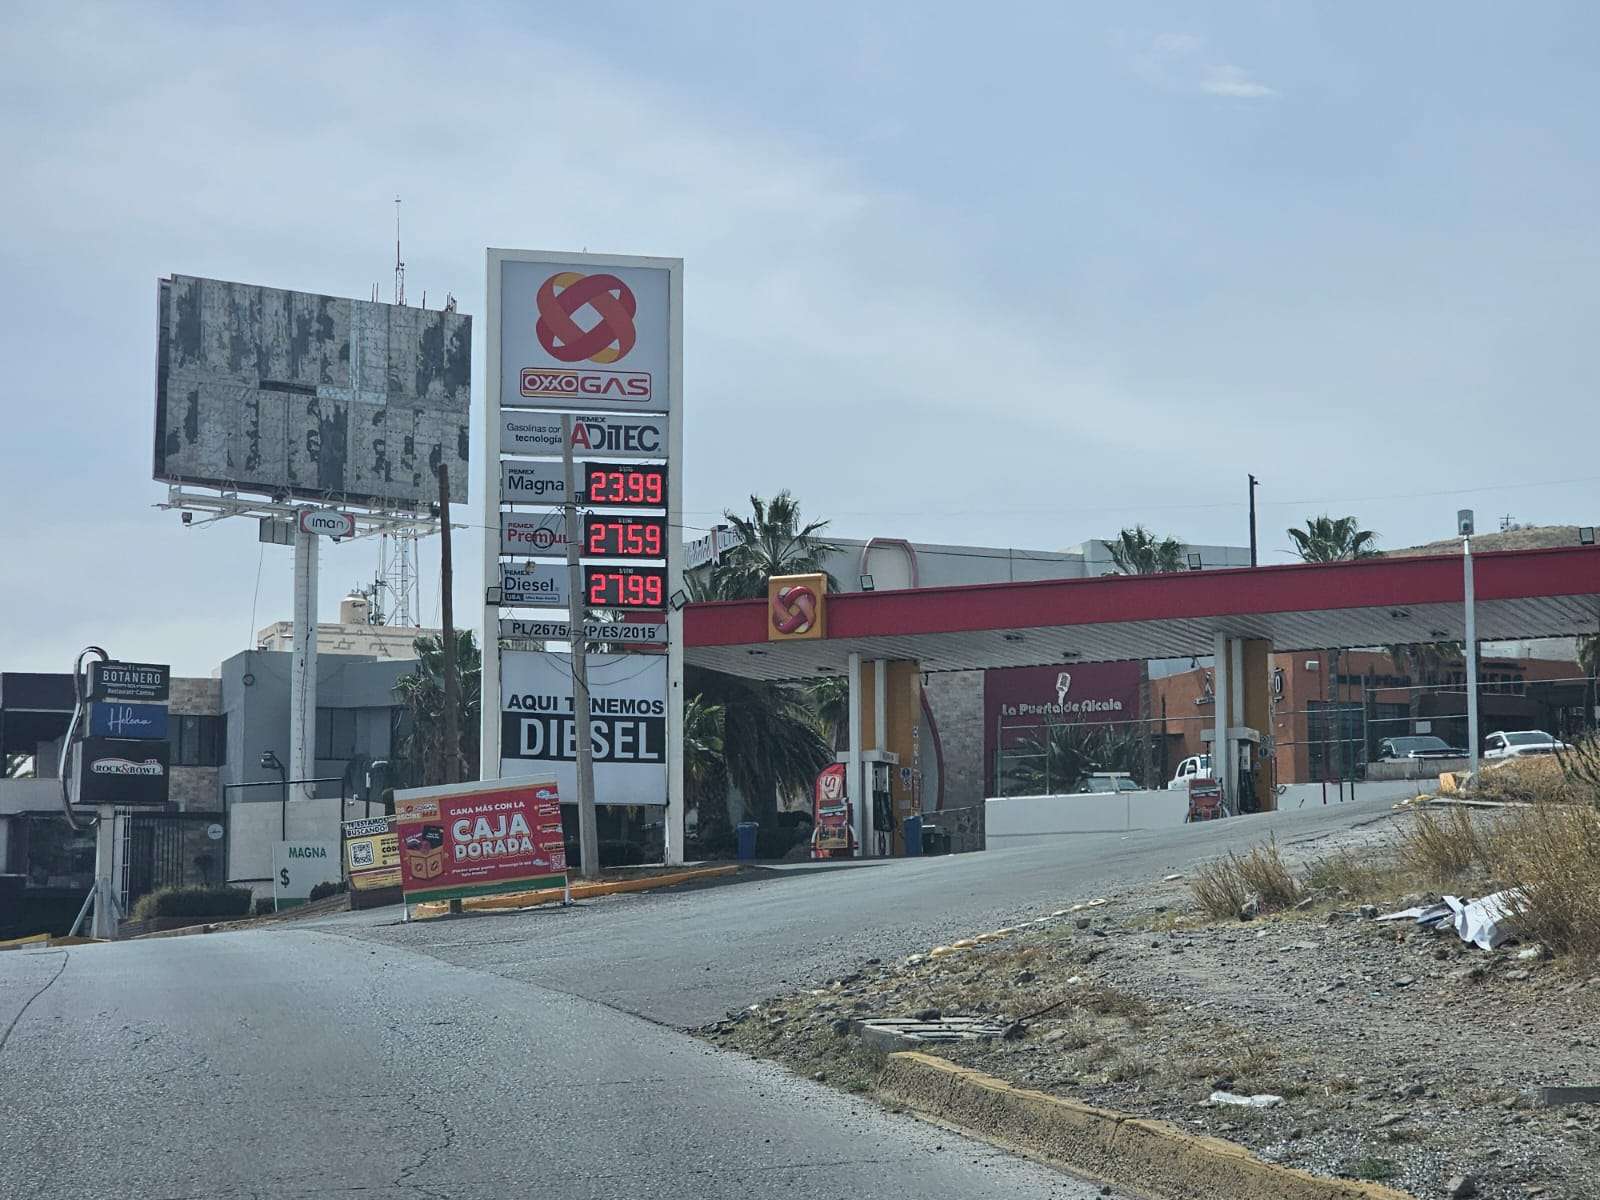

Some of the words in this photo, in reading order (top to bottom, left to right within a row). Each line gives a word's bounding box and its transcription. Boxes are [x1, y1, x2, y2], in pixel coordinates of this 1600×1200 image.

[506, 423, 546, 433] Gasolinas
[508, 476, 564, 495] Magna
[591, 472, 662, 503] 23.99
[312, 516, 344, 528] iman
[507, 529, 567, 544] Premiu
[590, 523, 661, 554] 27.59
[504, 577, 554, 592] Diesel
[590, 573, 662, 605] 27.99
[103, 670, 161, 684] BOTANERO
[507, 694, 558, 711] AQUI
[565, 696, 664, 715] TNEMOS
[519, 718, 659, 760] DIESEL
[450, 807, 474, 816] GANA
[494, 802, 513, 811] CON
[513, 801, 525, 809] LA
[452, 813, 531, 842] CAJA
[289, 847, 328, 858] MAGNA
[455, 837, 534, 861] DORADA
[280, 868, 291, 888] $
